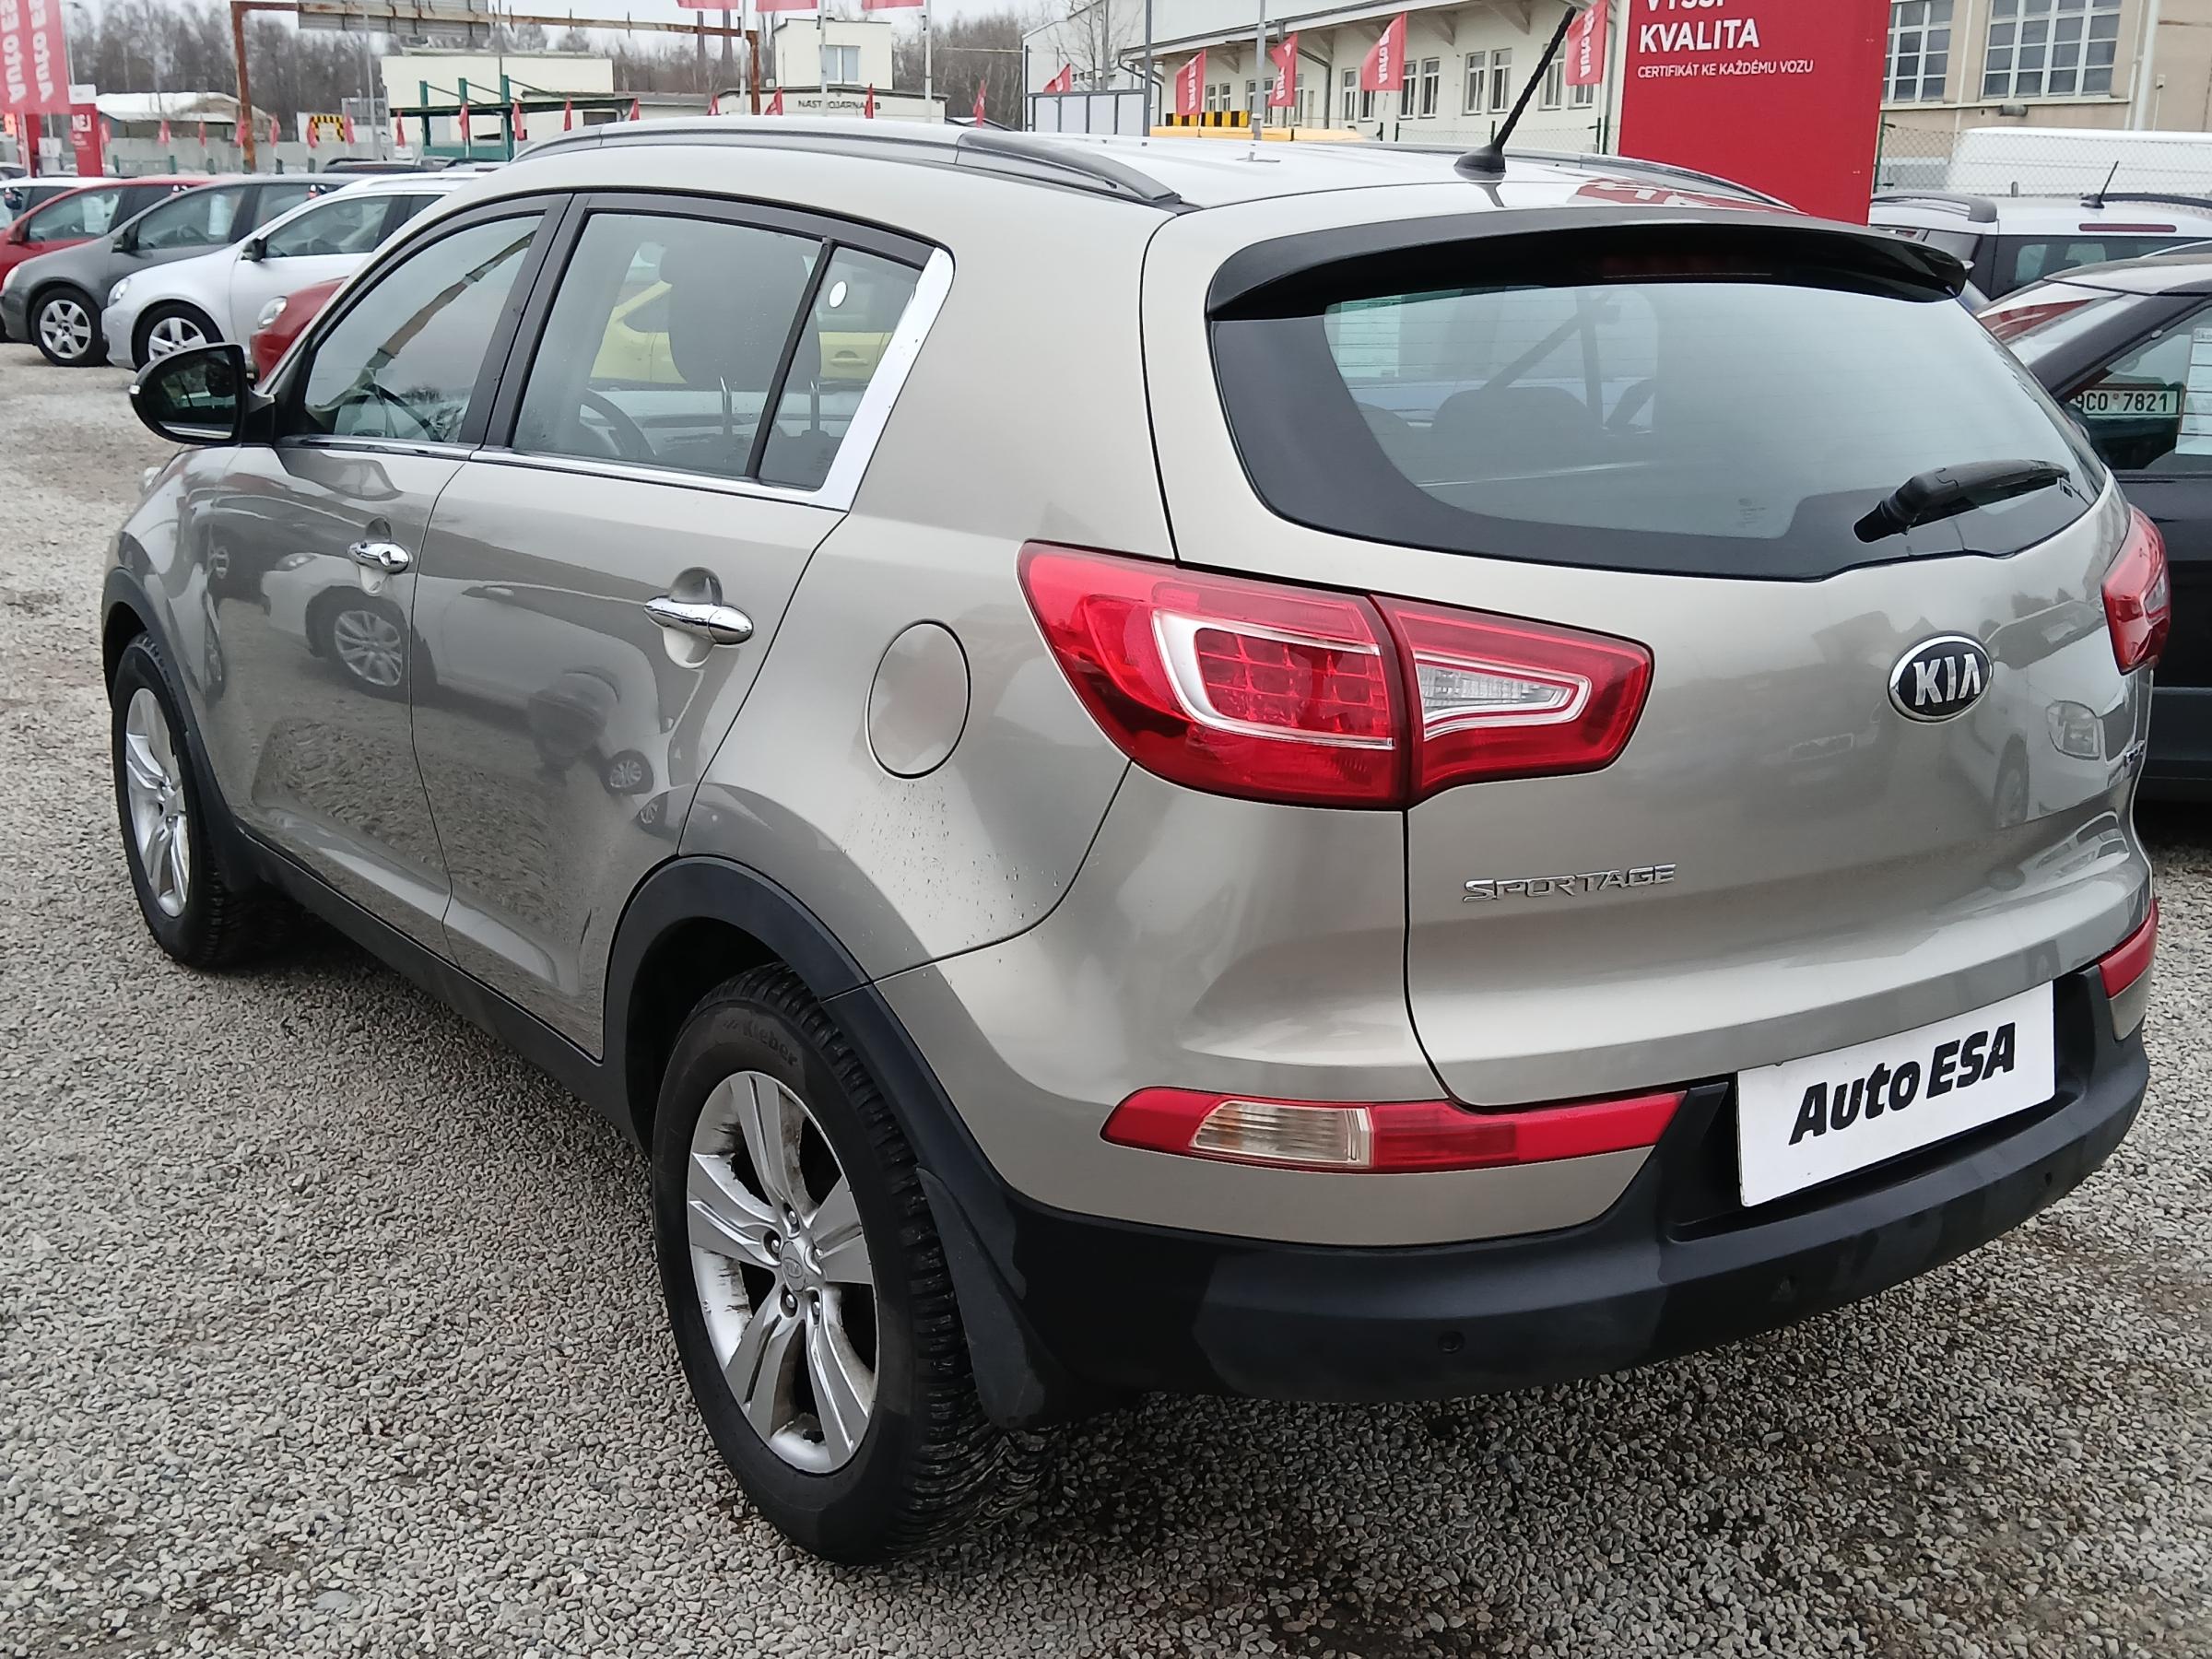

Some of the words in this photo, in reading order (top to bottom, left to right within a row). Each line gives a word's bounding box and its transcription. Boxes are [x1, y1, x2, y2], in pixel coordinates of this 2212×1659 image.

[1639, 18, 1759, 53] KVALITA
[1637, 62, 1700, 78] CERTIFIKÁT
[1701, 63, 1716, 76] KE
[1719, 59, 1777, 76] KAŽDÉMU
[1780, 60, 1814, 73] VOZU
[2123, 393, 2168, 412] 7821
[1912, 653, 1981, 706] KIA
[1463, 864, 1677, 902] SPORTAGE
[741, 1018, 799, 1066] Kleber
[1788, 1061, 1922, 1147] Auto
[1925, 1021, 2017, 1100] ESA
